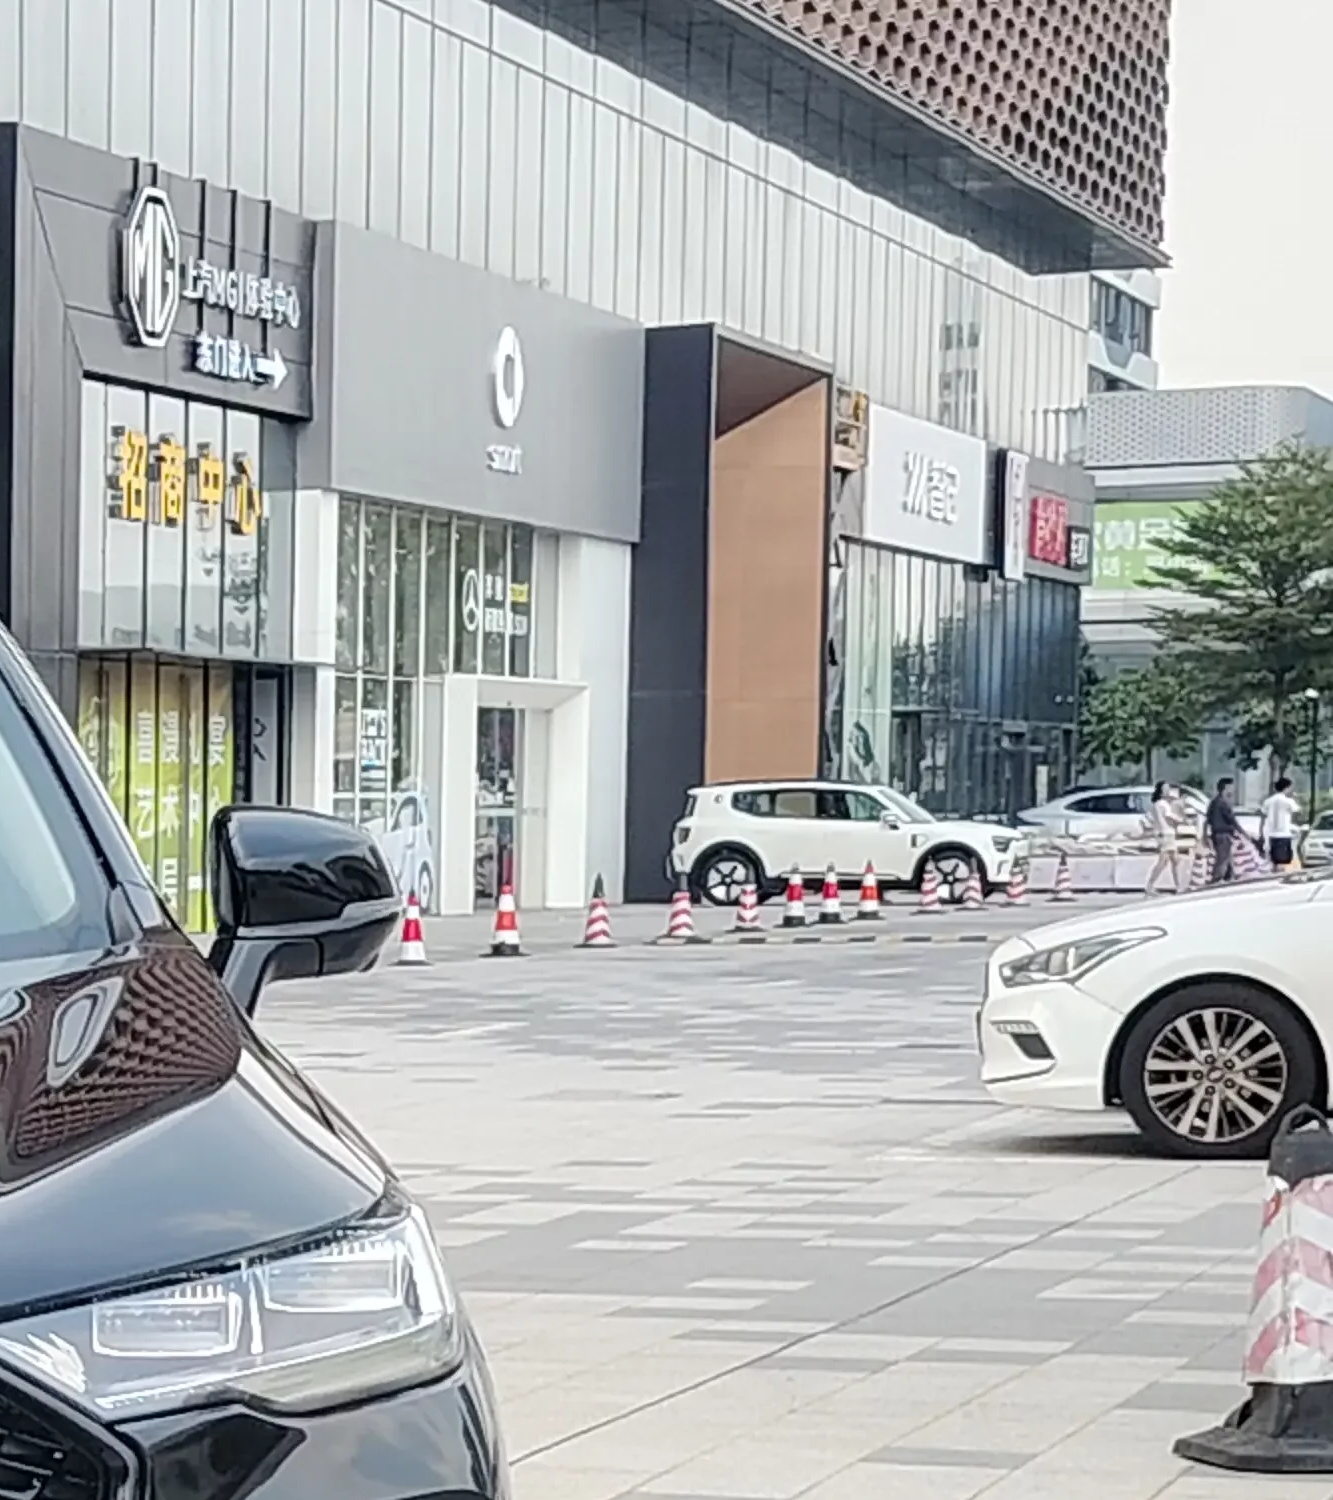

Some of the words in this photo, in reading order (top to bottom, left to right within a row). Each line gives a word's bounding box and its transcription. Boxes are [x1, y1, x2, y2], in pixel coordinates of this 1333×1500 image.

[132, 194, 177, 340] MG
[117, 428, 262, 535] 招商中心
